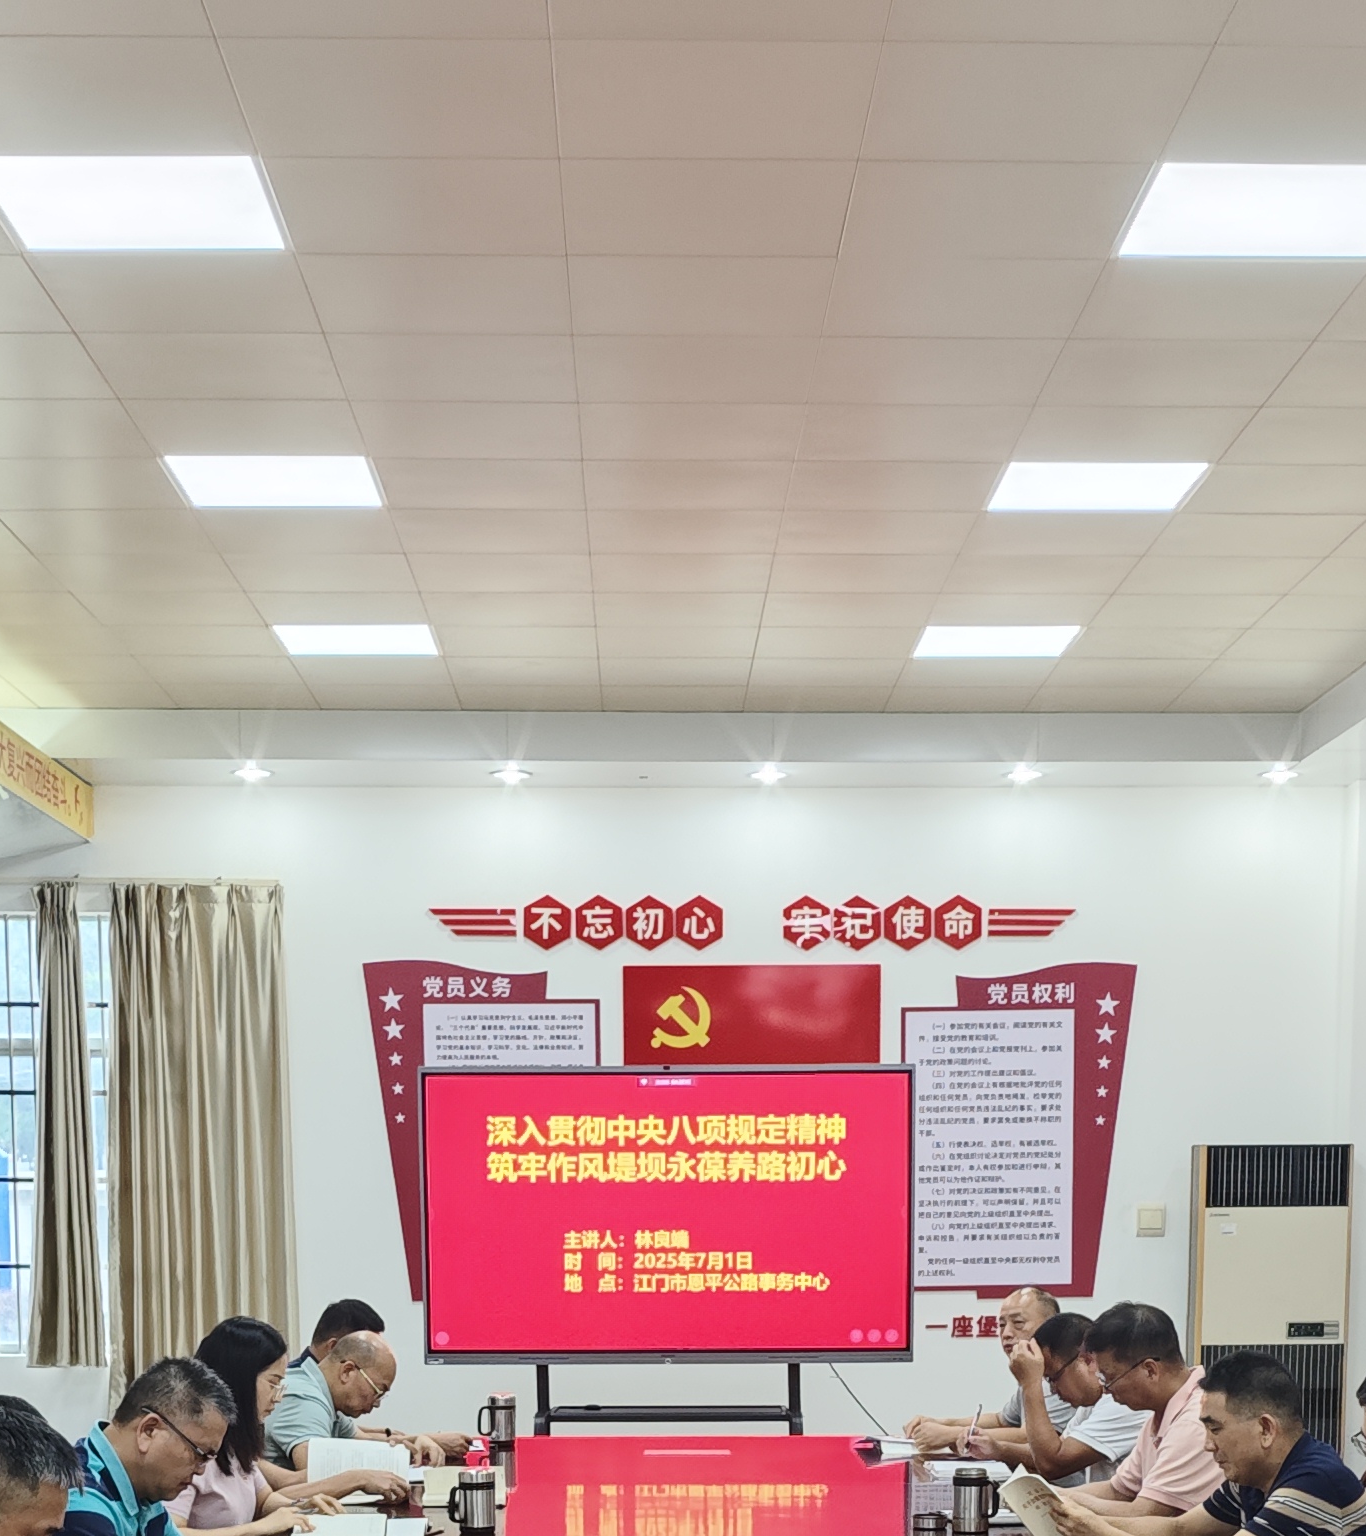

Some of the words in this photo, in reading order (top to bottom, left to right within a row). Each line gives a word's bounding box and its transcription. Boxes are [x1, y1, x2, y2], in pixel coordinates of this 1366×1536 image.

[530, 905, 716, 941] 不忘初心
[790, 904, 976, 941] 牢记使命
[422, 976, 512, 998] 党员义务
[987, 981, 1075, 1005] 党员权利
[486, 1113, 846, 1147] 深入贯彻中央八项规定精神
[486, 1150, 846, 1183] 筑牢作风堤坝永葆养路初心
